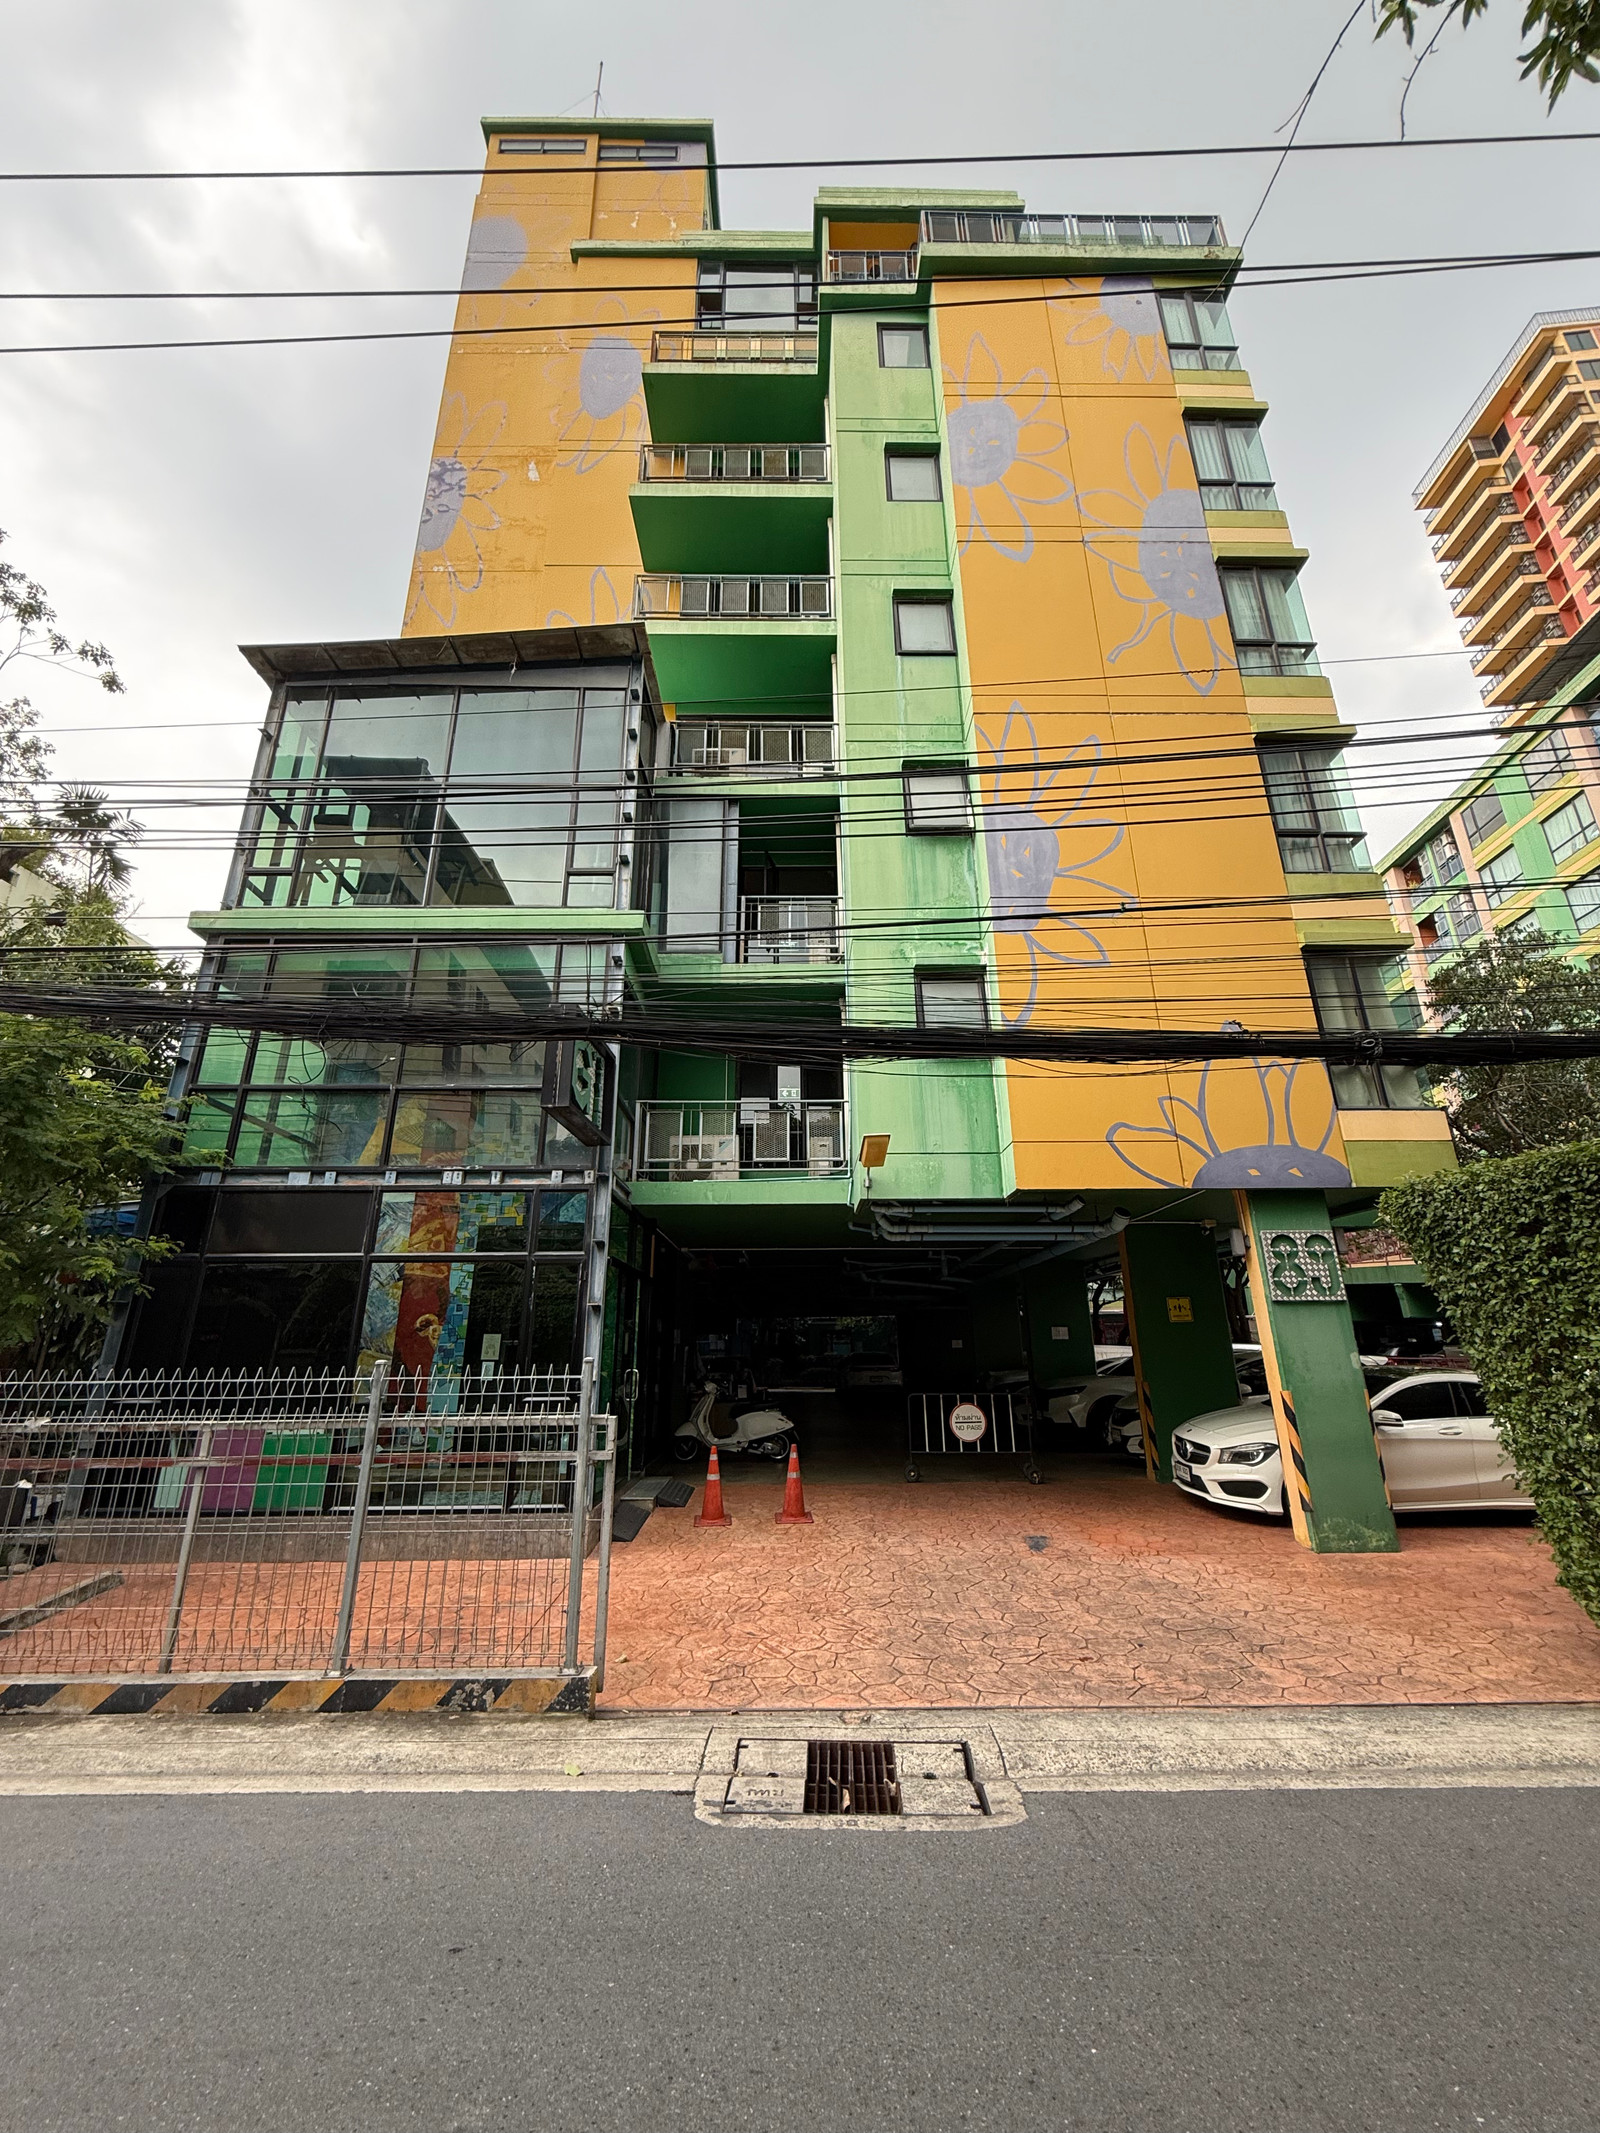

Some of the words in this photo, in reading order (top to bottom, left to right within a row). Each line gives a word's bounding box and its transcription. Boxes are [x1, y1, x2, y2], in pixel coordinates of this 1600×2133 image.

[1270, 1234, 1341, 1296] 89
[954, 1413, 981, 1421] ห้ามผ่าน
